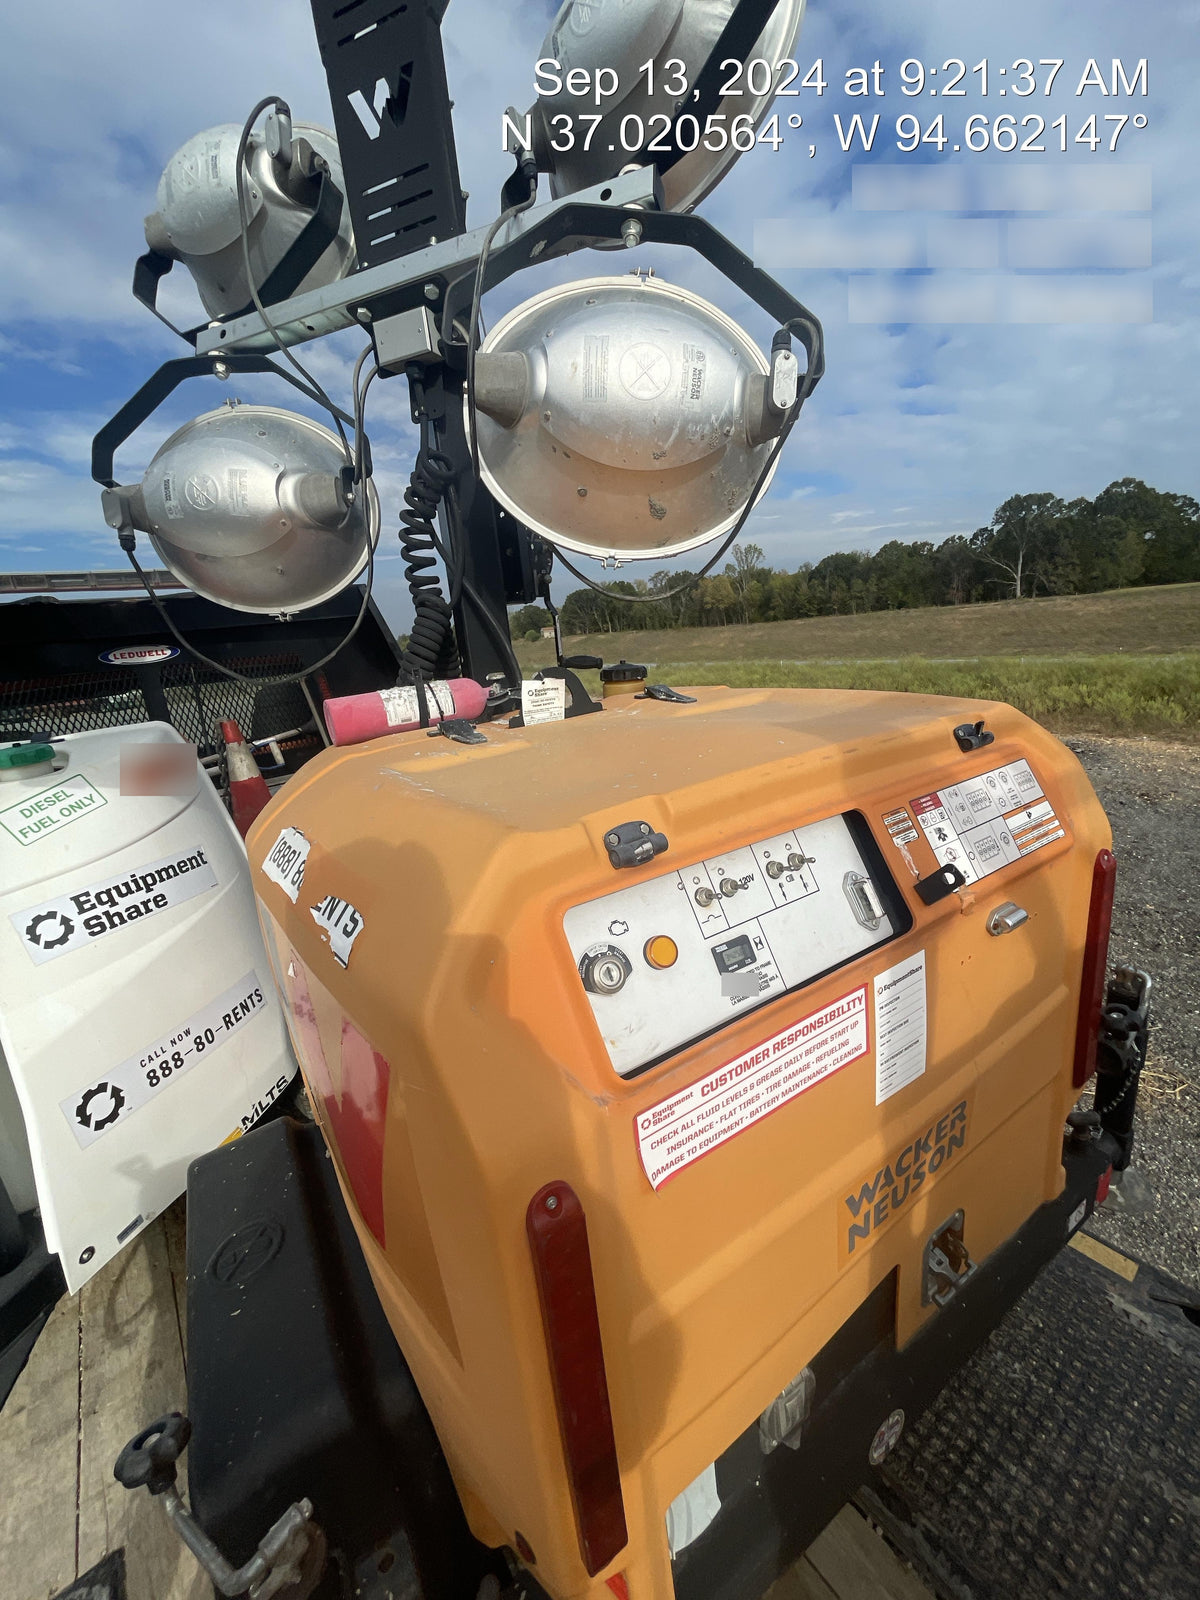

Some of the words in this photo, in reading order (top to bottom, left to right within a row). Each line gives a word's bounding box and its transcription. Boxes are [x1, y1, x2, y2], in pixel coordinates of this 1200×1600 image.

[690, 367, 698, 400] NEUSON
[113, 648, 168, 660] LEDWELL
[18, 815, 60, 839] FUEL
[59, 793, 96, 817] ONLY
[19, 789, 74, 819] DIESEL
[268, 836, 302, 880] (888)
[738, 873, 755, 885] 120V
[69, 850, 208, 916] Equipment
[82, 892, 168, 937] Share
[883, 965, 923, 992] EquipmentShare
[139, 1046, 167, 1068] CALL
[170, 1027, 191, 1047] NOW
[145, 988, 263, 1088] 888-80-RENTS
[701, 1048, 770, 1098] CUSTOMER
[772, 994, 864, 1055] RESPONSIBILITY
[650, 1127, 679, 1150] CHECK
[680, 1119, 695, 1132] ALL
[696, 1104, 720, 1123] FLUID
[721, 1087, 748, 1108] LEVELS
[756, 1064, 782, 1087] GREASE
[784, 1052, 804, 1069] DAILY
[804, 1037, 829, 1056] BEFORE
[829, 1025, 850, 1041] START
[850, 1020, 859, 1030] UP
[651, 1091, 694, 1120] Equipment
[666, 1123, 715, 1155] INSURANCE
[719, 1108, 740, 1124] FLAT
[739, 1093, 761, 1111] TIRES
[765, 1081, 782, 1095] TIRE
[783, 1062, 811, 1083] DAMAGE
[815, 1038, 850, 1064] REFUELING
[651, 1152, 685, 1182] DAMAGE
[686, 1146, 697, 1157] TO
[699, 1117, 744, 1150] EQUIPMENT
[749, 1094, 780, 1118] BATTERY
[781, 1064, 829, 1098] MAINTENANCE
[832, 1044, 863, 1066] CLEANING
[652, 1110, 675, 1127] Share
[844, 1100, 968, 1218] WACKER
[847, 1125, 967, 1255] NEUSON
